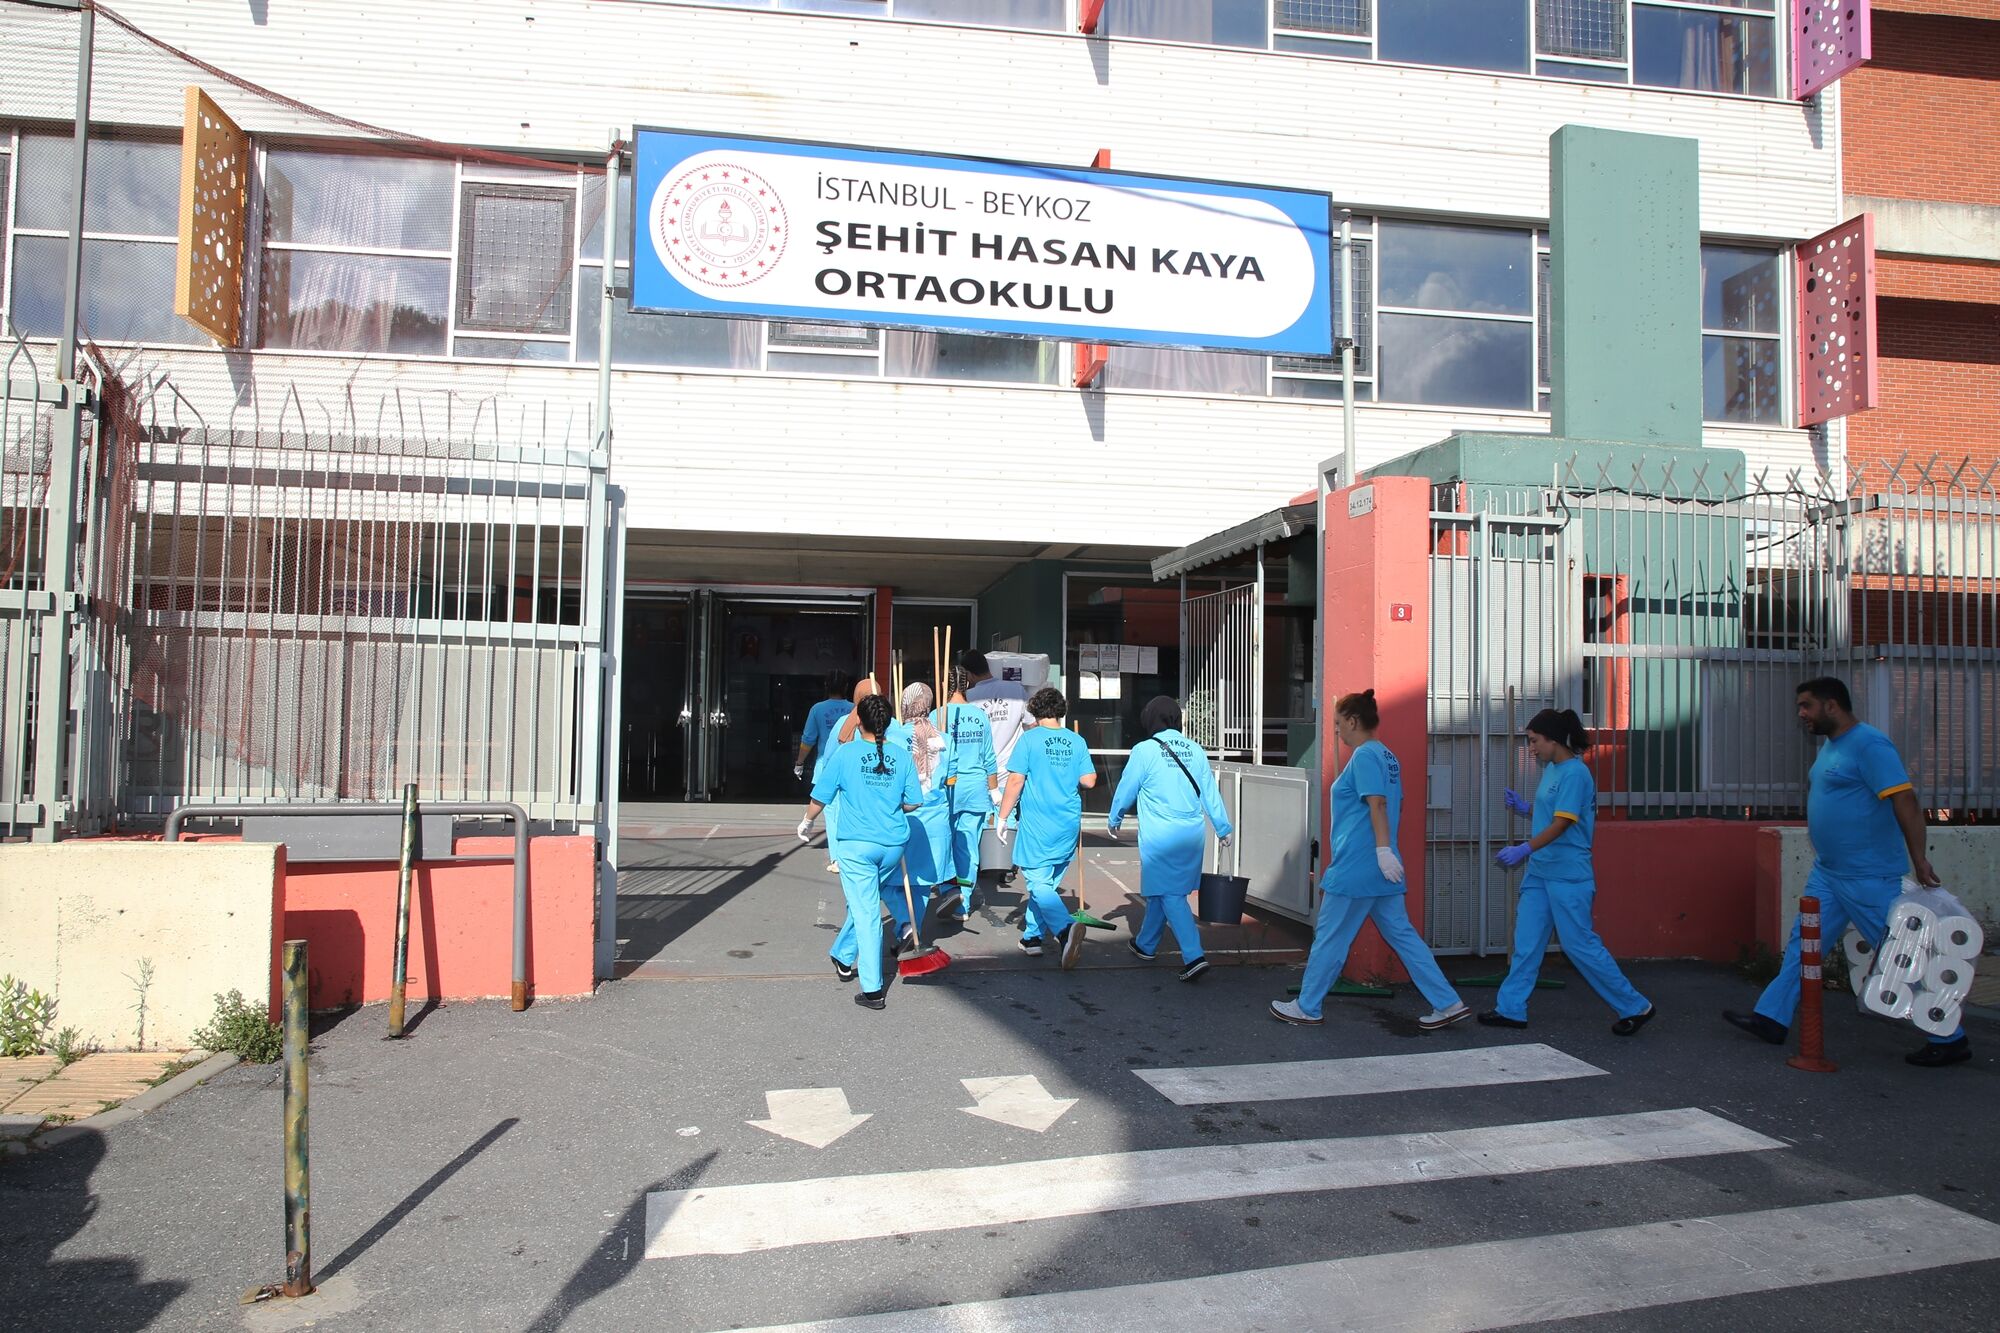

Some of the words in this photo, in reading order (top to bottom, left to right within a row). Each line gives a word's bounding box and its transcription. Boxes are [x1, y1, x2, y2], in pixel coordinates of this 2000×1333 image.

[817, 171, 956, 210] İSTANBUL
[983, 191, 1091, 222] BEYKOZ
[815, 220, 957, 256] ŞEHİT
[972, 232, 1136, 271] HASAN
[1152, 248, 1265, 282] KAYA
[814, 268, 1114, 314] ORTAOKULU
[1397, 607, 1405, 618] 3
[1045, 736, 1072, 748] BEYKOZ
[860, 752, 897, 767] BEYOZ
